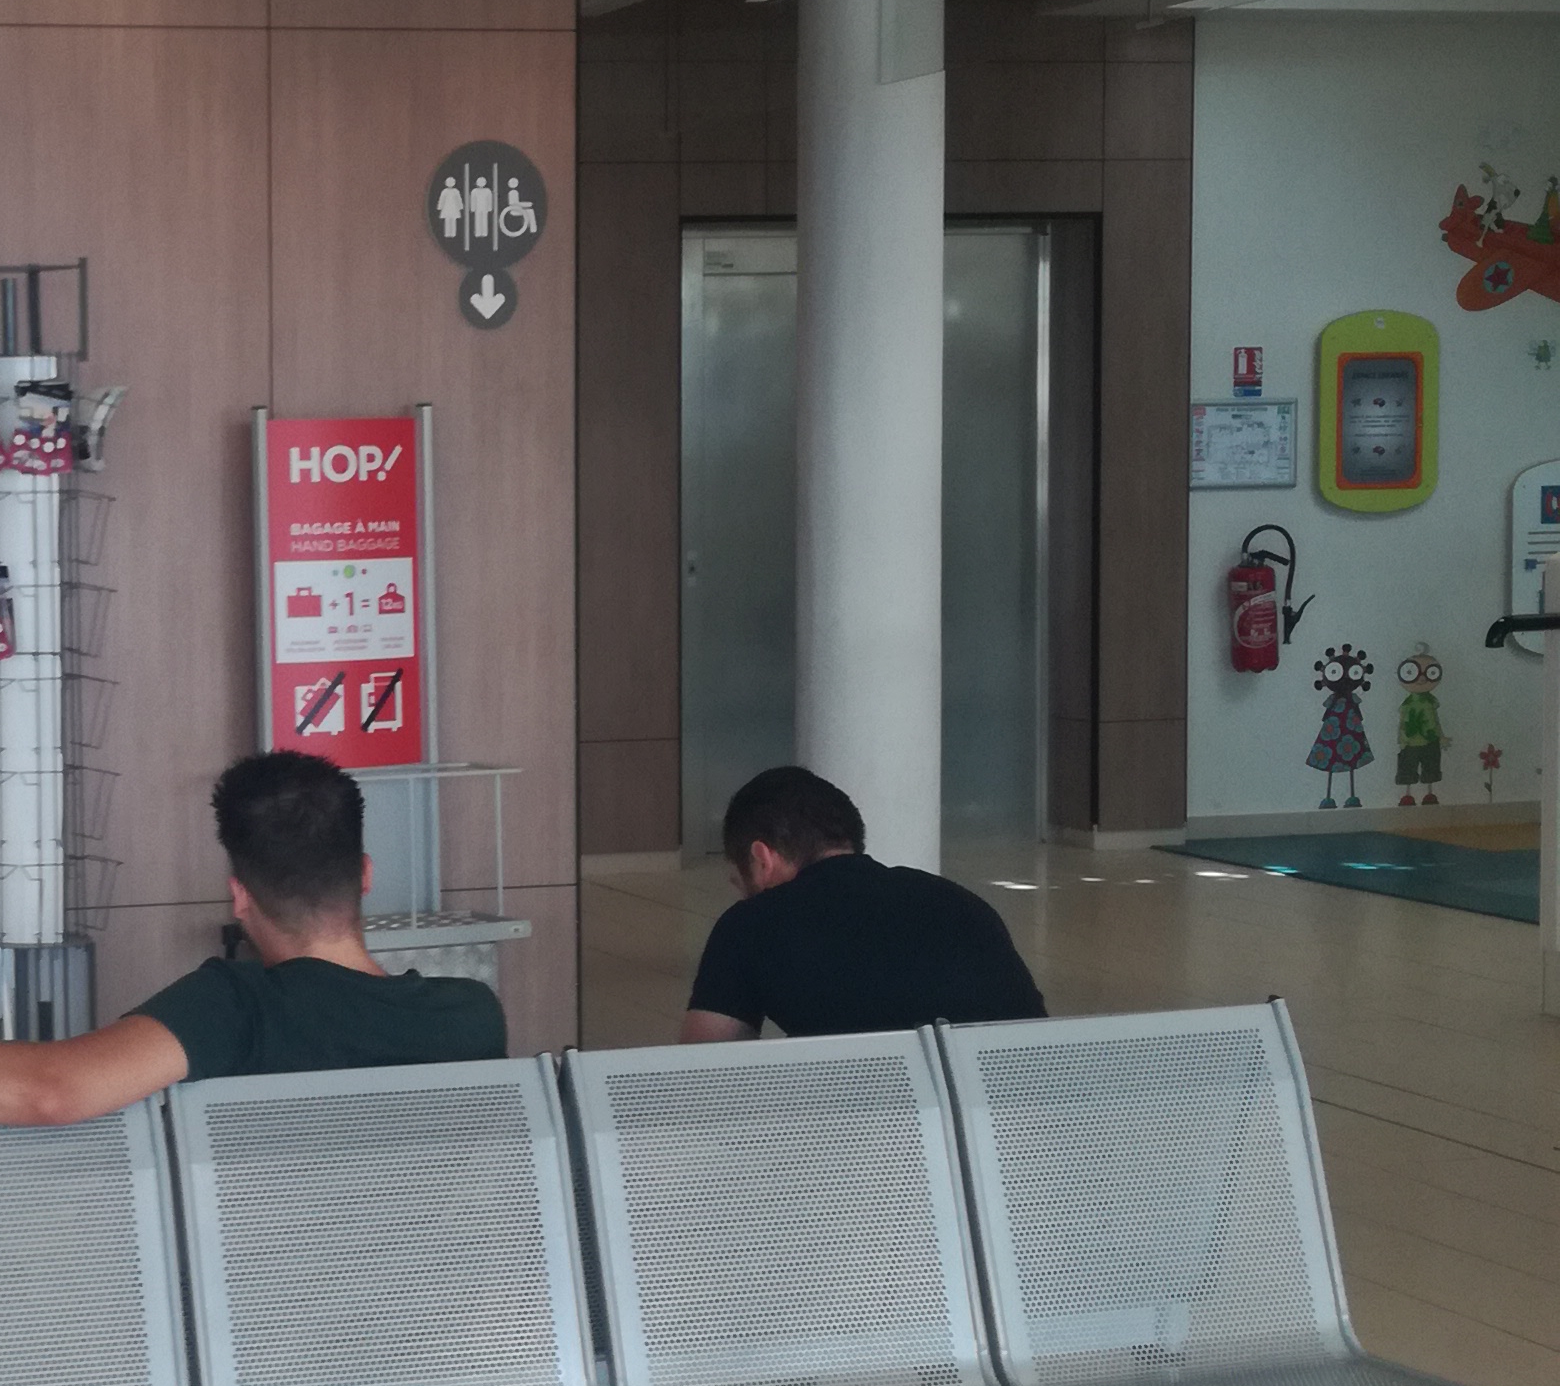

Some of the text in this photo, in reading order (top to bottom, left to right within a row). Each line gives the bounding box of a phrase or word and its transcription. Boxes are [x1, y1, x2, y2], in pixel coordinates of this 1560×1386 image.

[288, 444, 403, 483] HOP!
[289, 518, 400, 536] BAGAGE À MAIN
[290, 537, 400, 552] HAND BAGGAGE
